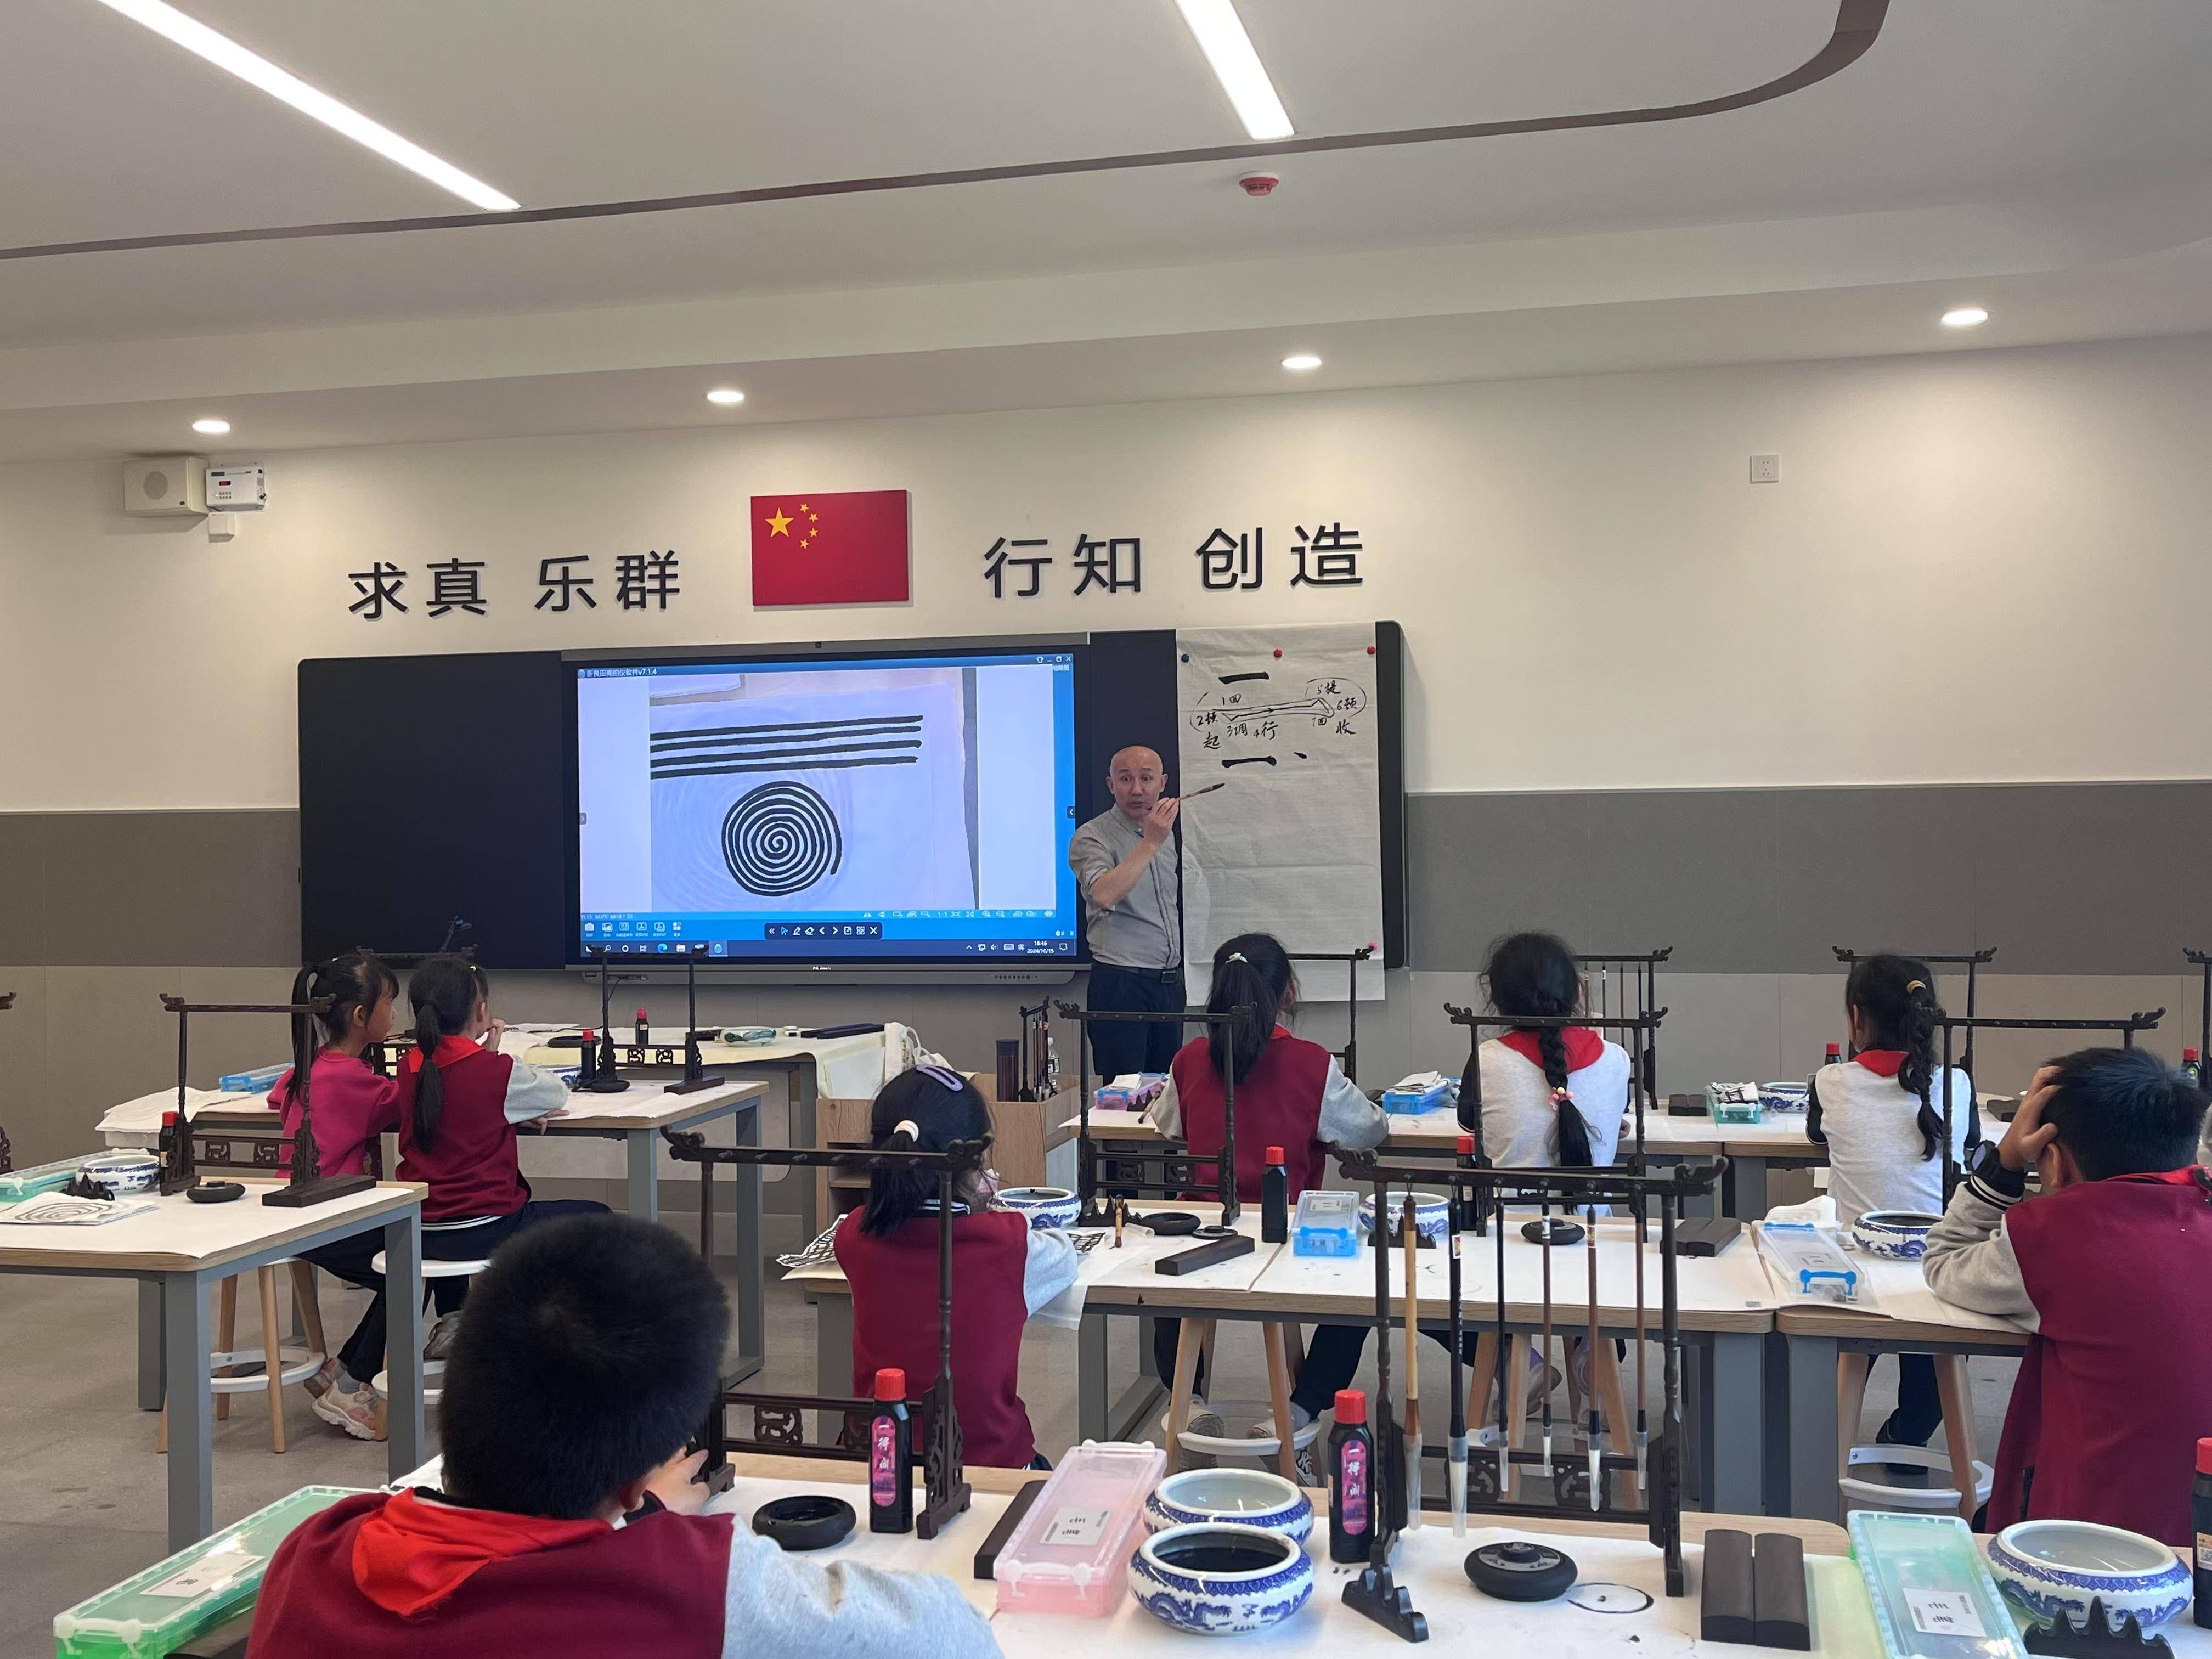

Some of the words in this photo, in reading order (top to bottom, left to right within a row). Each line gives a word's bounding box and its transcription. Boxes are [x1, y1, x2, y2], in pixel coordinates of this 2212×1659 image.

[984, 533, 1141, 599] 行知
[1195, 522, 1363, 590] 创造
[348, 557, 487, 619] 求真
[534, 550, 680, 612] 乐群
[1203, 731, 1222, 750] 起
[1335, 718, 1357, 735] 收
